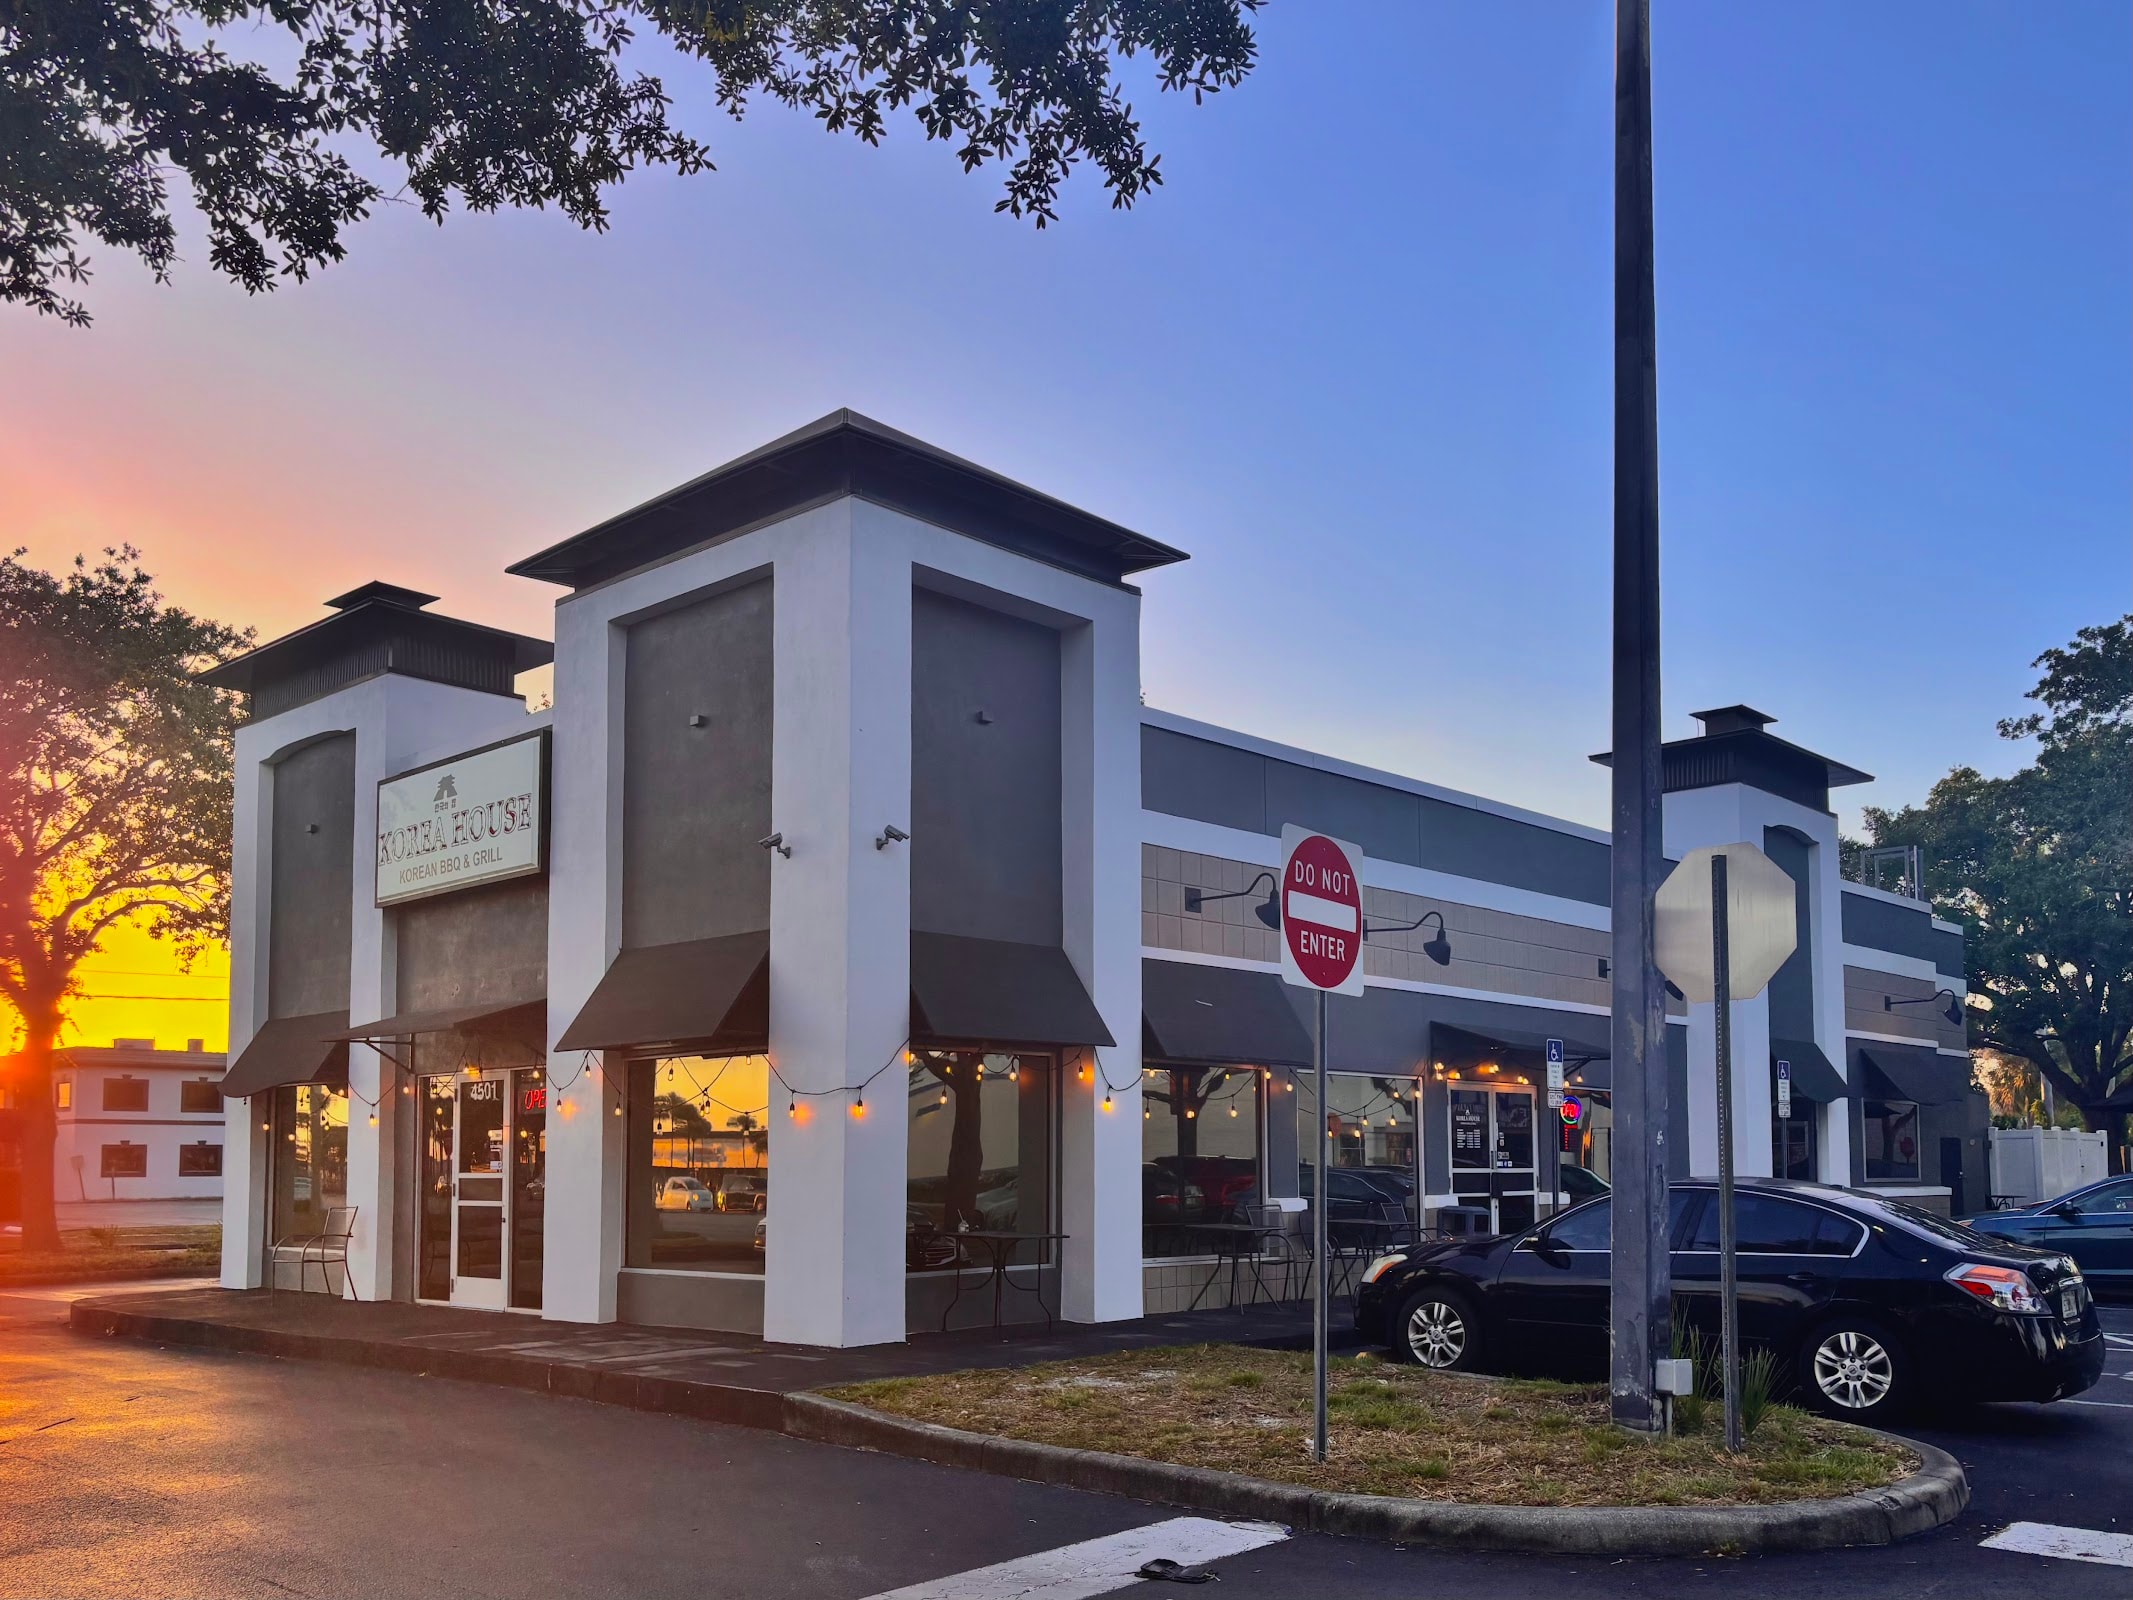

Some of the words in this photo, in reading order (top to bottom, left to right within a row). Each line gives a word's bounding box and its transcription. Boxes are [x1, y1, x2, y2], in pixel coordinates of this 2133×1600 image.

[378, 817, 447, 867] KOREA
[451, 793, 532, 847] HOUSE
[400, 863, 438, 884] KOREAN
[440, 855, 461, 874] BBQ
[463, 854, 470, 869] &
[473, 847, 503, 866] GRILL
[1295, 860, 1315, 887] DO
[1322, 868, 1350, 896] NOT
[1300, 930, 1346, 962] ENTER
[470, 1081, 499, 1100] 4501
[525, 1088, 547, 1110] OPE
